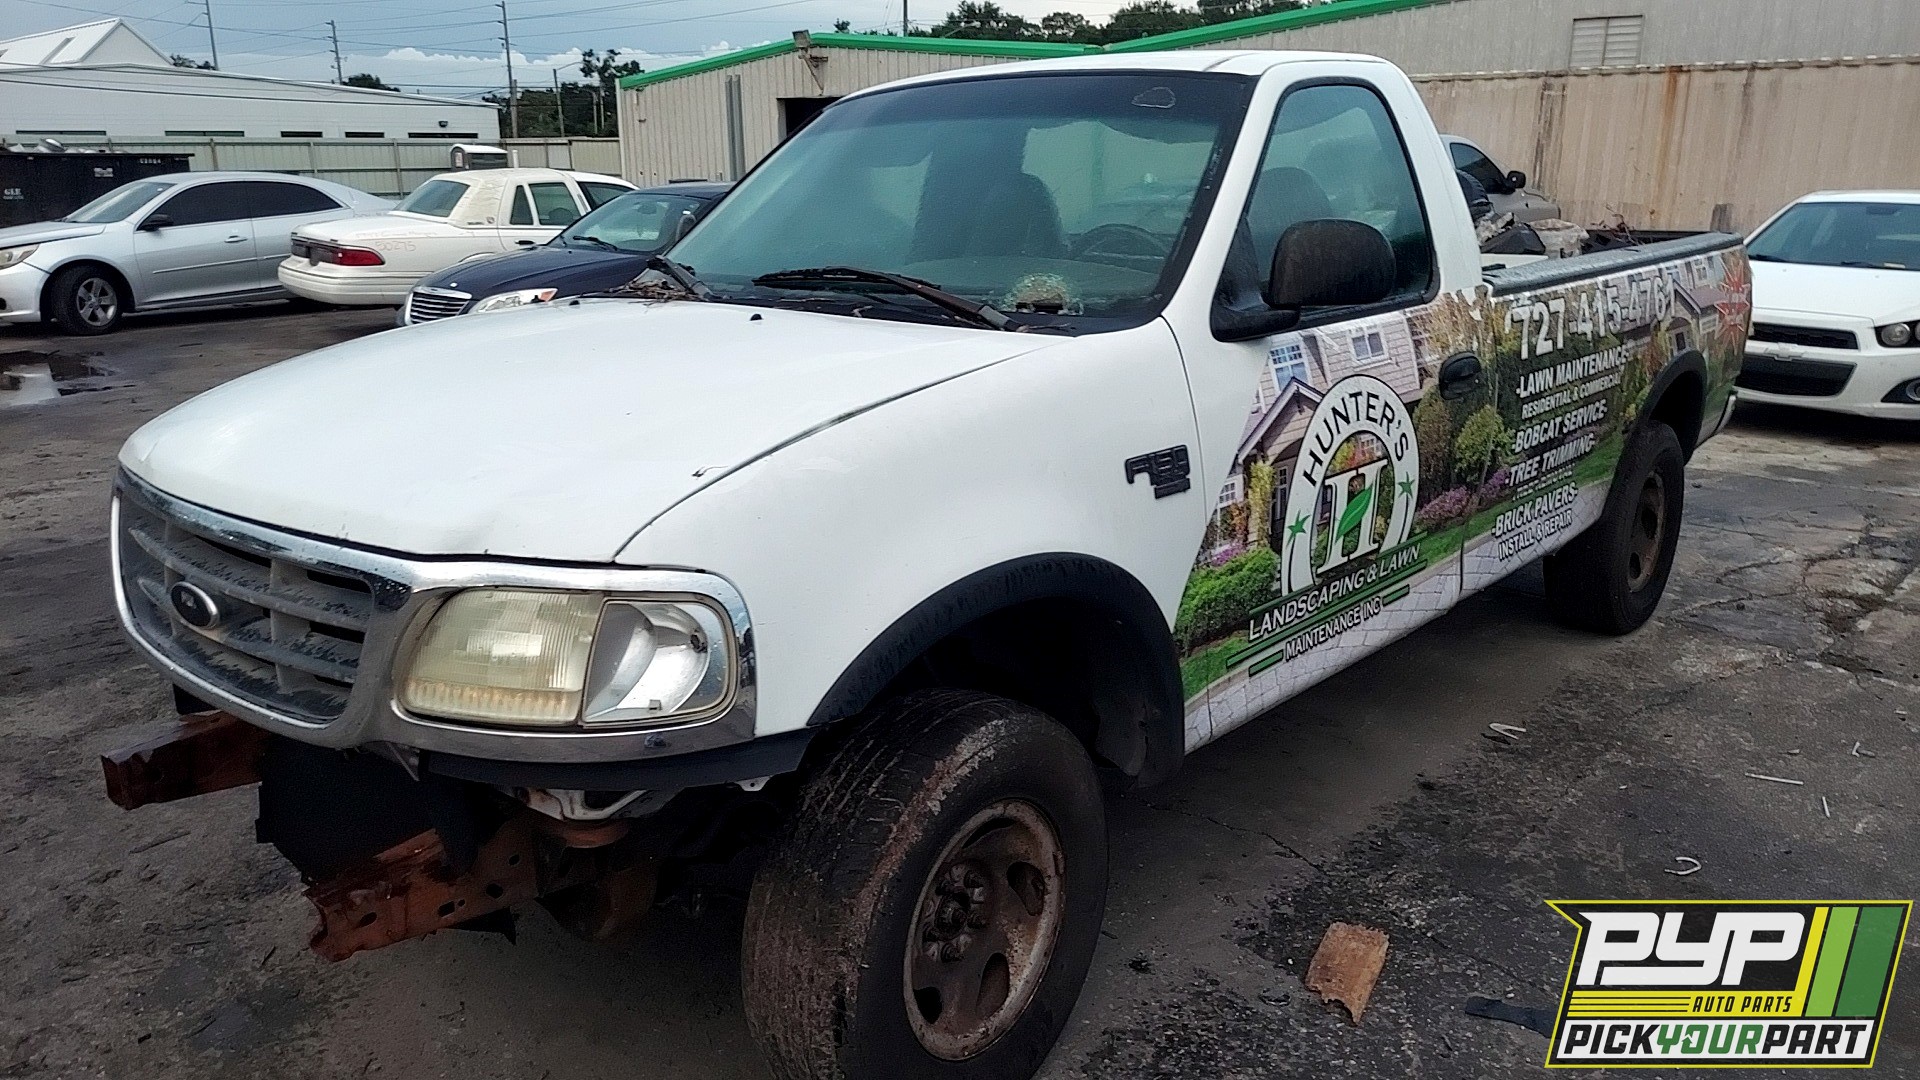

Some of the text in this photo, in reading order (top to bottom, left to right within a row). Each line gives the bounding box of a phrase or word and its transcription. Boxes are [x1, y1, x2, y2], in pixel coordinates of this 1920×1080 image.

[1510, 273, 1676, 361] 727-415-4761
[1302, 390, 1410, 487] HUNTER'S
[1521, 389, 1571, 420] RESIDENTIAL
[1572, 386, 1579, 401] &
[1498, 508, 1572, 562] INSTALL & REPAIR
[1249, 542, 1422, 642] LANDSCAPING & LAWN
[1284, 594, 1383, 662] MAINTENANCE INC
